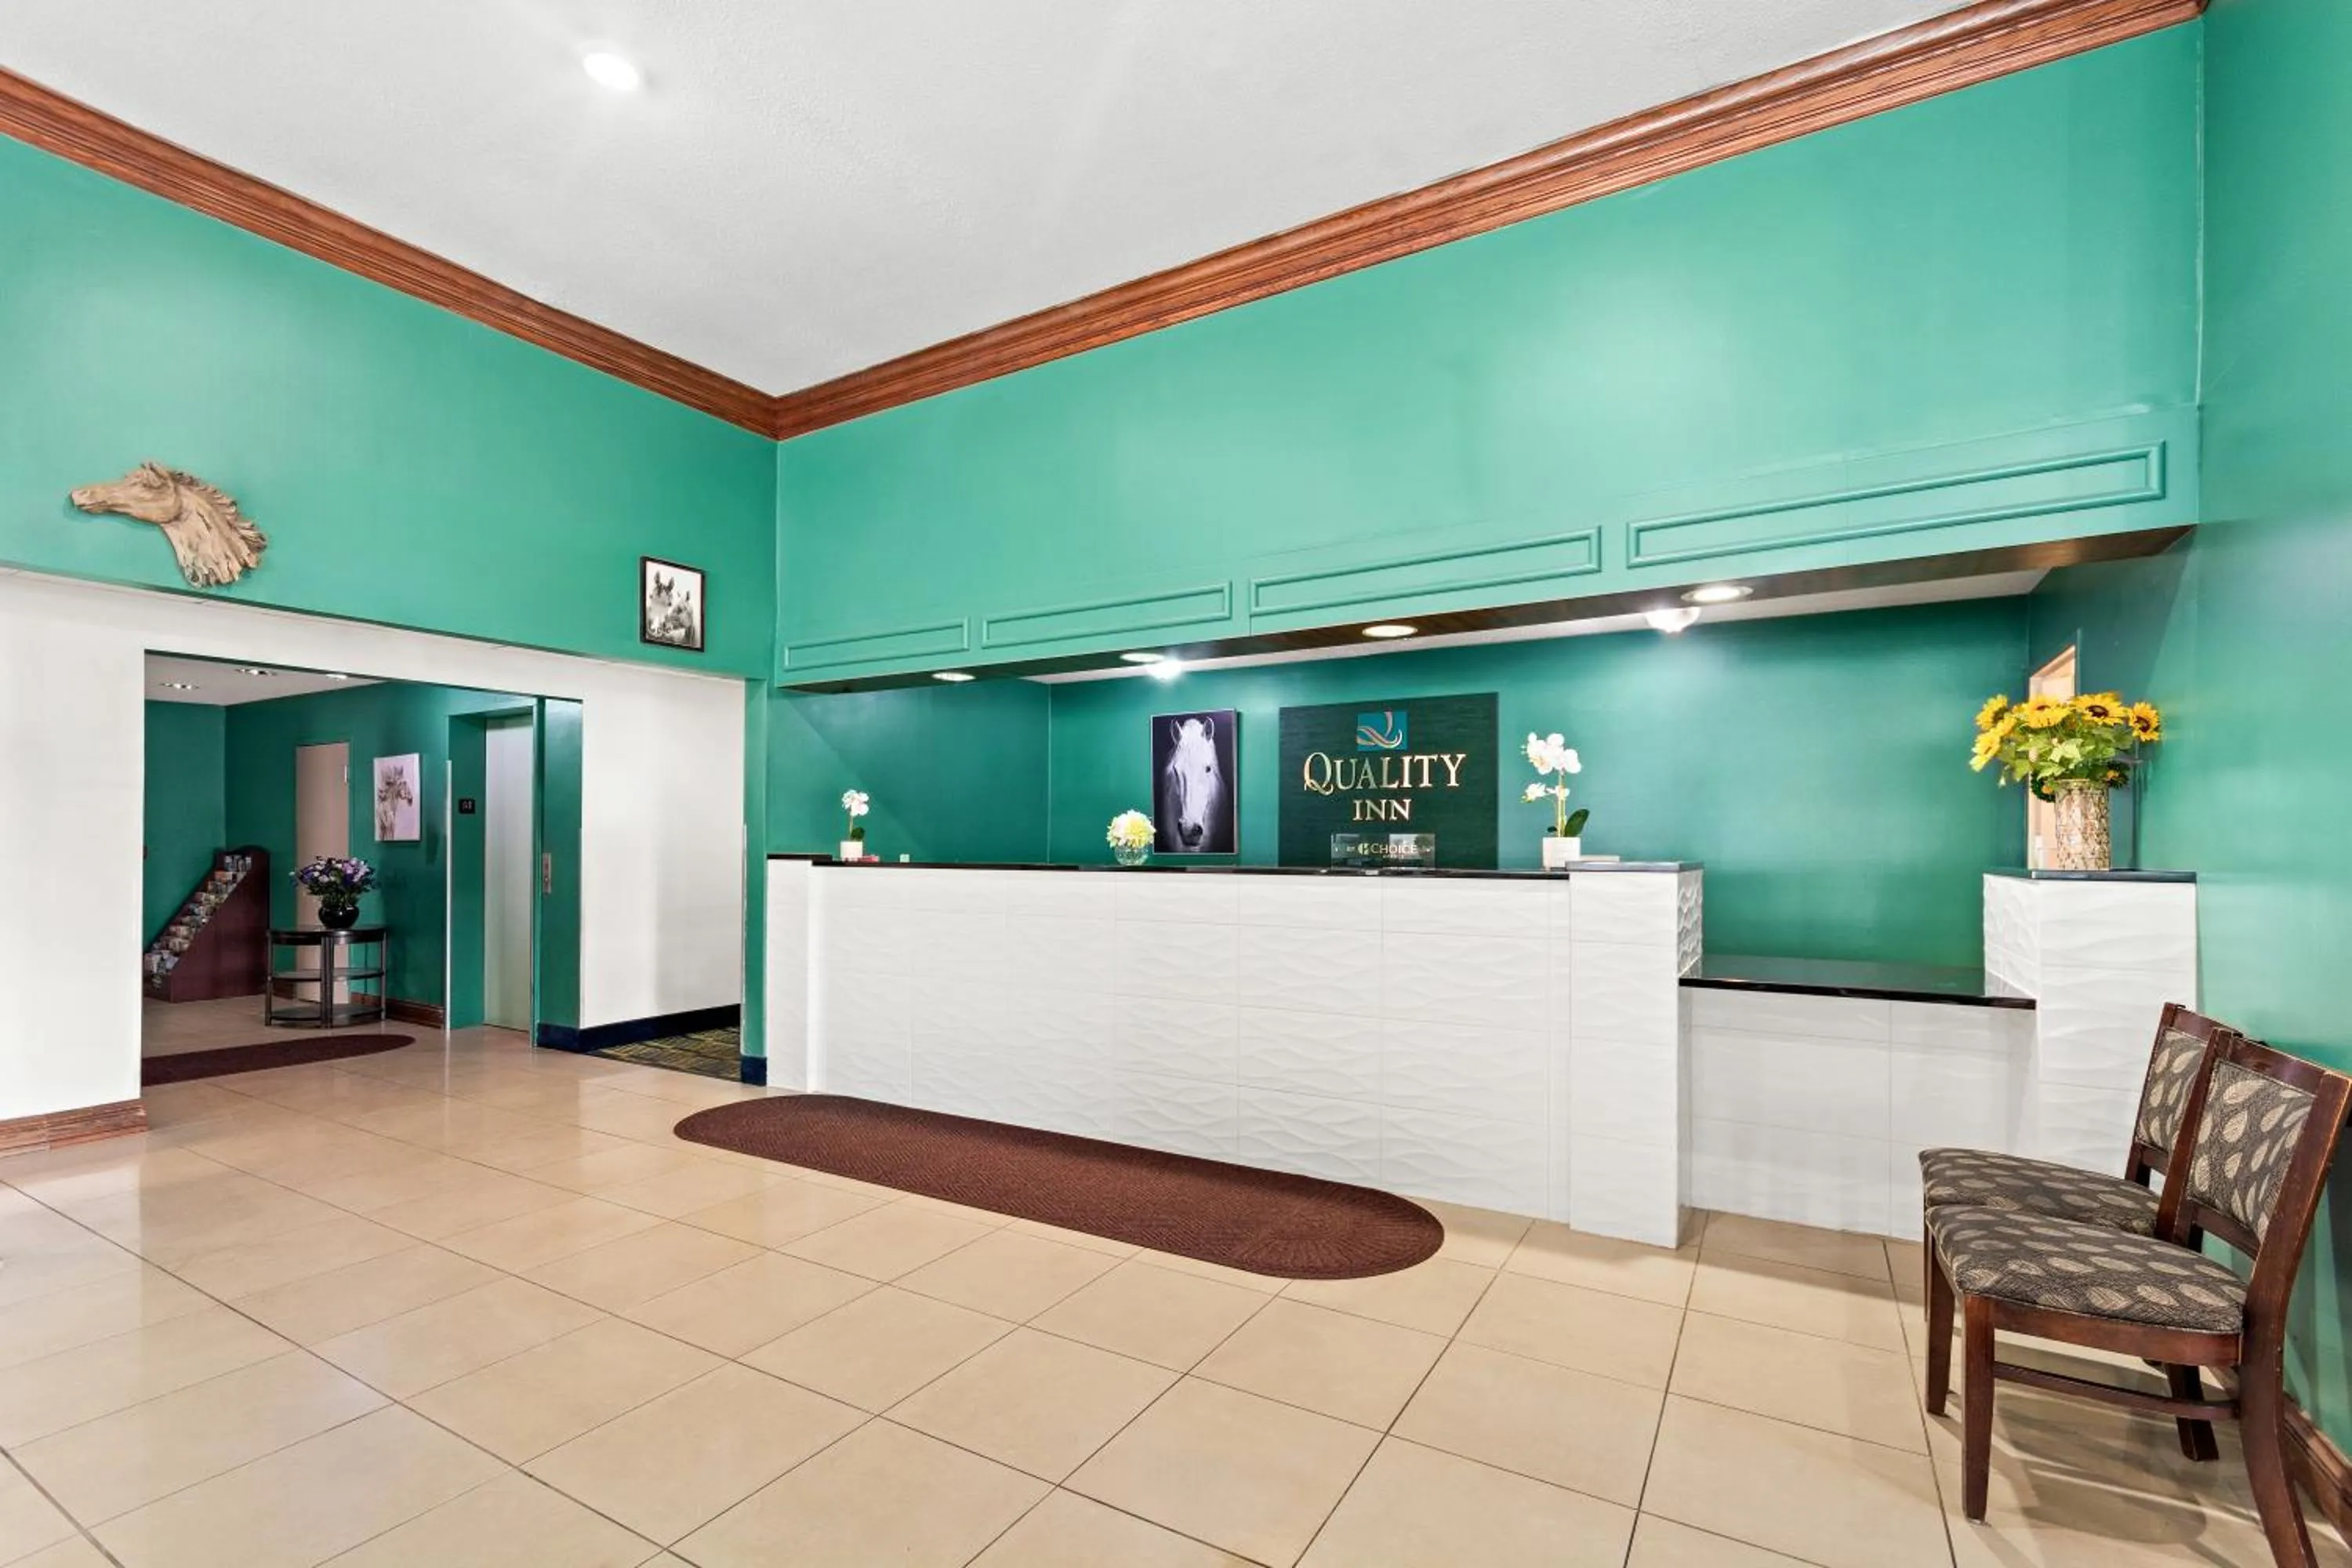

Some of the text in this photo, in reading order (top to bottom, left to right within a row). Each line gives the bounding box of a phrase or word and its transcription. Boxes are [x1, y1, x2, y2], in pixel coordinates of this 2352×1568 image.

[1304, 752, 1466, 795] QUALITY
[1352, 798, 1412, 821] INN
[1370, 843, 1418, 855] CHOICE
